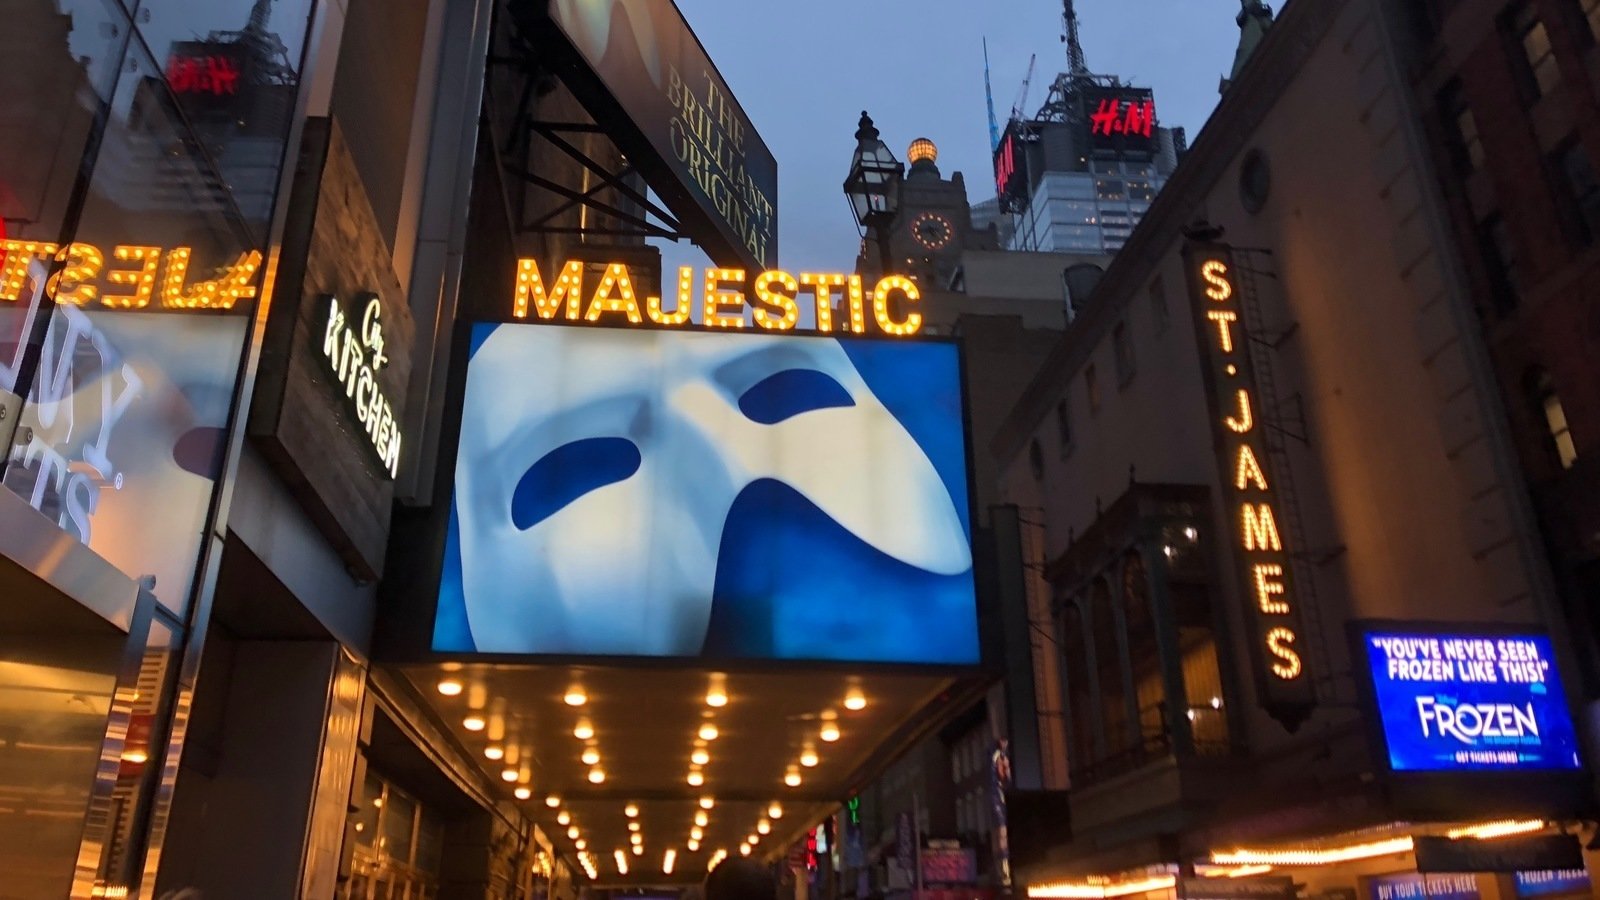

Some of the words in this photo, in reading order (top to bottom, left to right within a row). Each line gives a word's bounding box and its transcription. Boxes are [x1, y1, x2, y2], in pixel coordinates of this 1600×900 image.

[704, 70, 745, 157] THE
[1090, 98, 1153, 138] H&M
[667, 63, 773, 238] BRILLIANT
[513, 258, 922, 335] MAJESTIC
[323, 298, 401, 480] KITCHEN
[1225, 389, 1301, 680] JAMES
[1372, 638, 1442, 661] "YOU'VE
[1443, 639, 1497, 661] NEVER
[1498, 640, 1539, 662] SEEN
[1388, 659, 1455, 682] FROZEN
[1458, 660, 1498, 683] LIKE
[1499, 660, 1549, 684] THIS!"
[1415, 695, 1539, 745] FROZEN
[1378, 884, 1393, 900] BUY
[1394, 882, 1417, 898] YOUR
[1417, 877, 1453, 897] TICKETS
[1455, 874, 1477, 892] HERE
